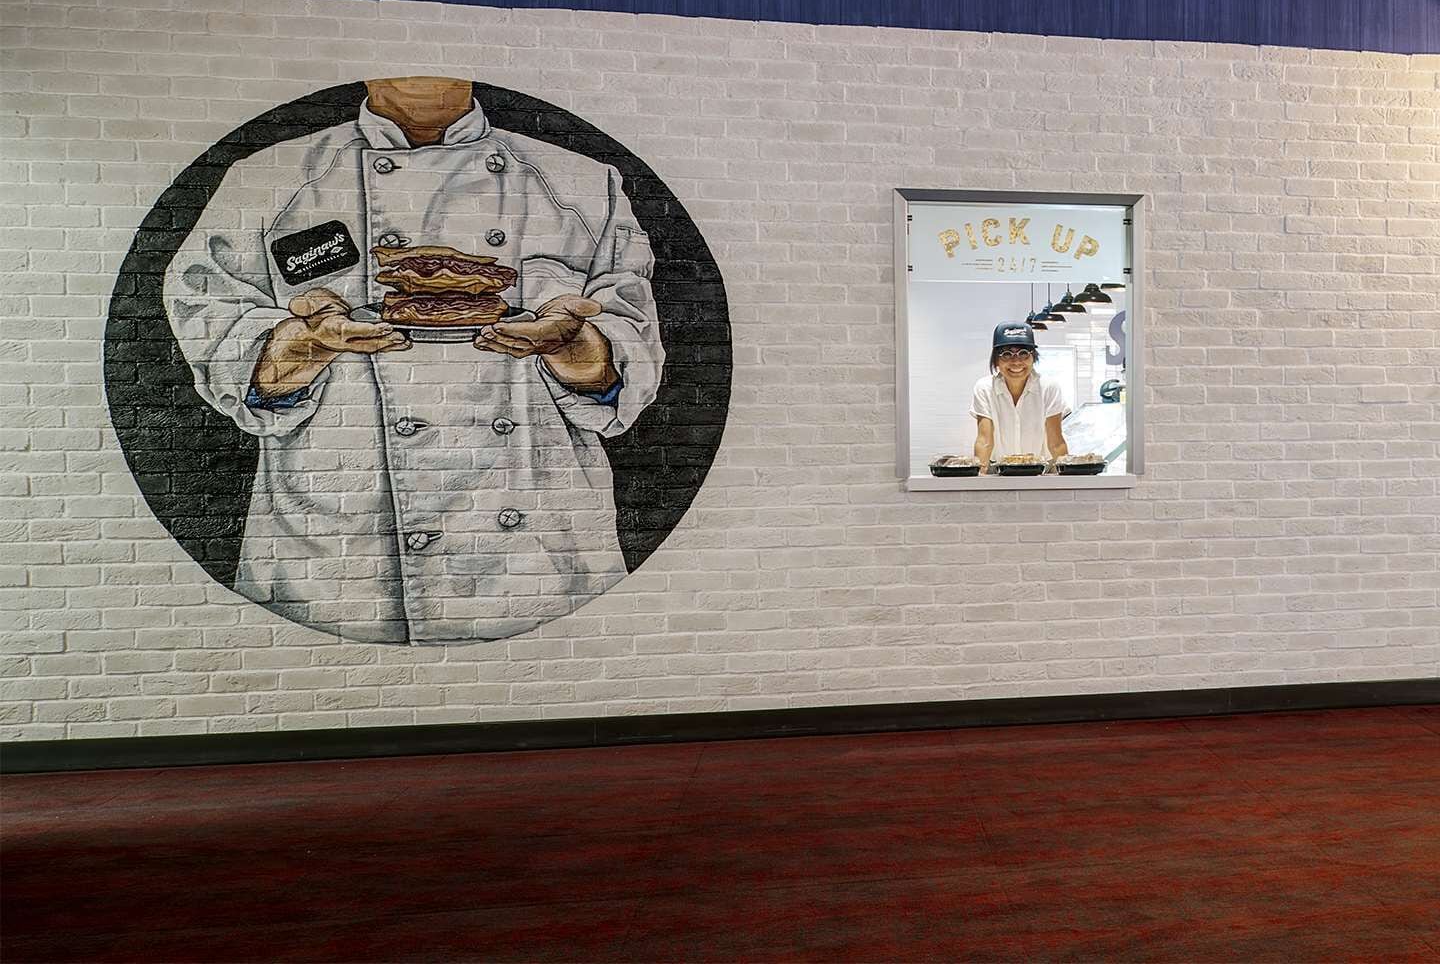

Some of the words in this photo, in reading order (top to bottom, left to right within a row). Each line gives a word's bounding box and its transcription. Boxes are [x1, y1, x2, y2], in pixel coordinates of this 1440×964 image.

[286, 232, 345, 271] Saginaw's
[937, 217, 1032, 259] PICK
[1050, 223, 1100, 261] UP
[997, 256, 1037, 273] 24/7
